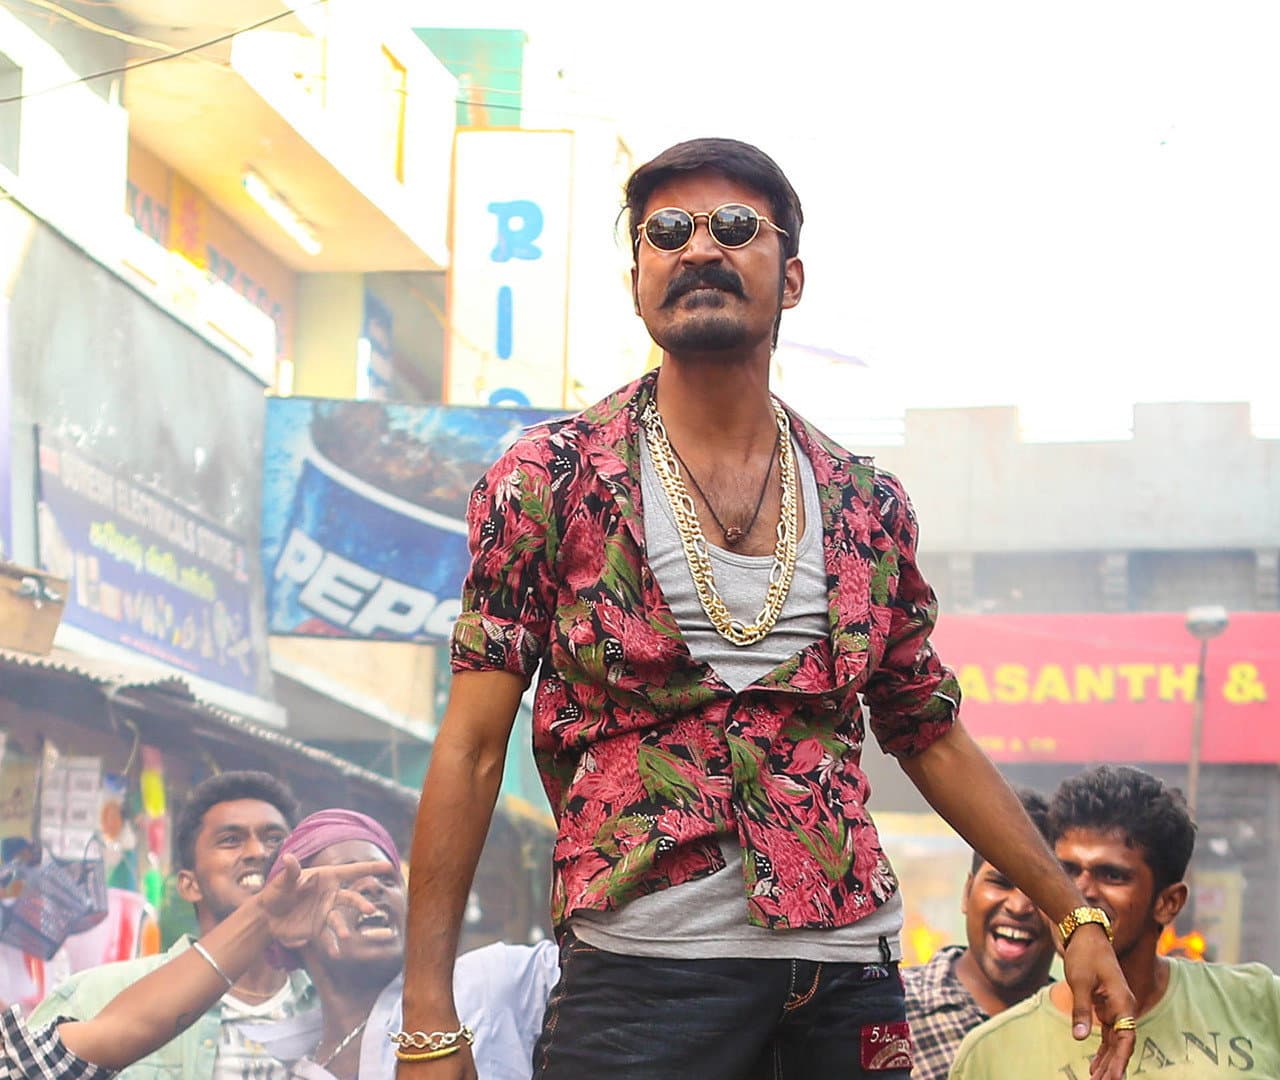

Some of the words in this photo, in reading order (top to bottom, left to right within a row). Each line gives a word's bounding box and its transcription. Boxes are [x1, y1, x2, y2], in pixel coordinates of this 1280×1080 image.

[487, 200, 544, 408] RI
[960, 663, 1202, 704] ASANTH
[1223, 662, 1267, 704] &
